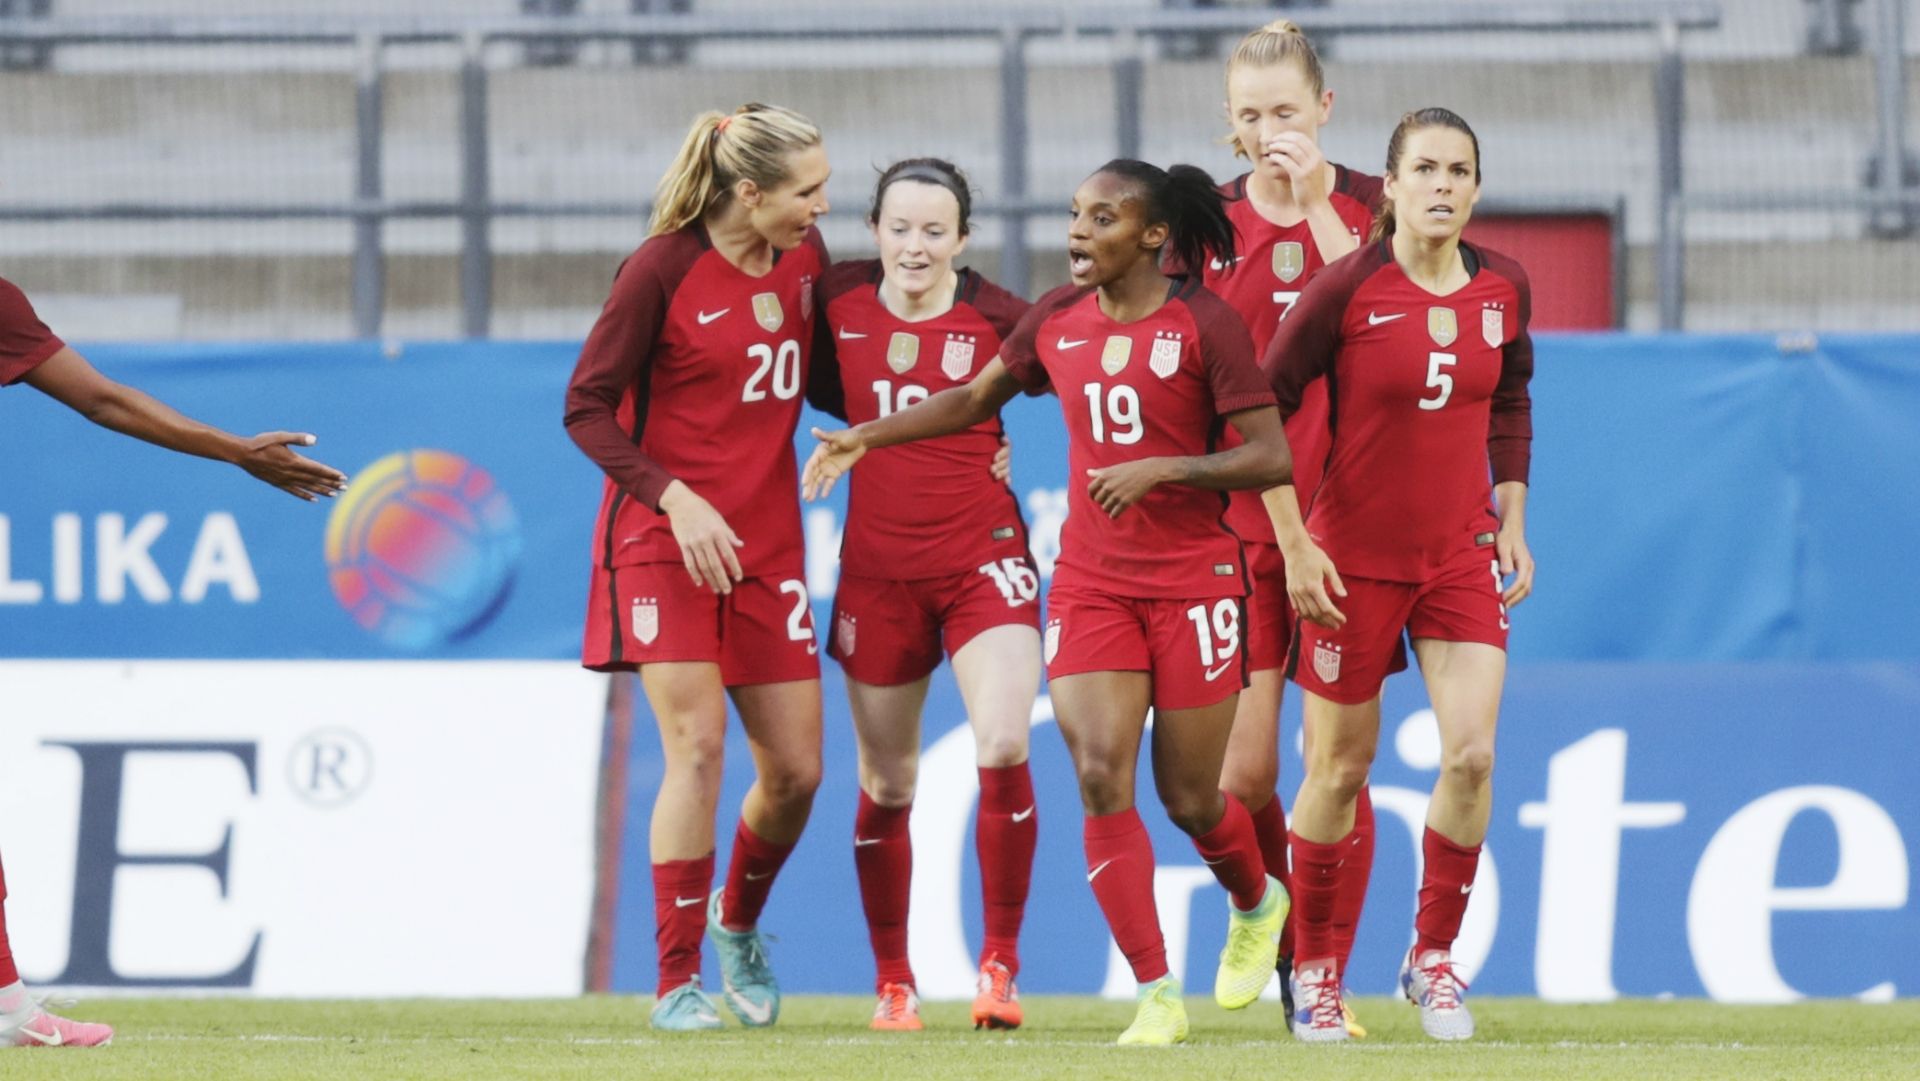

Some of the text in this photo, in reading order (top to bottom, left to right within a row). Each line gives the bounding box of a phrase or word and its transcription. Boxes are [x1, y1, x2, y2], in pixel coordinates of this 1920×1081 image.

[742, 338, 800, 402] 20
[1417, 351, 1458, 410] 5
[1083, 381, 1145, 446] 19
[0, 511, 261, 604] LIKA
[978, 556, 1040, 608] 16
[780, 579, 815, 641] 2
[1186, 598, 1240, 667] 19
[20, 740, 264, 989] E
